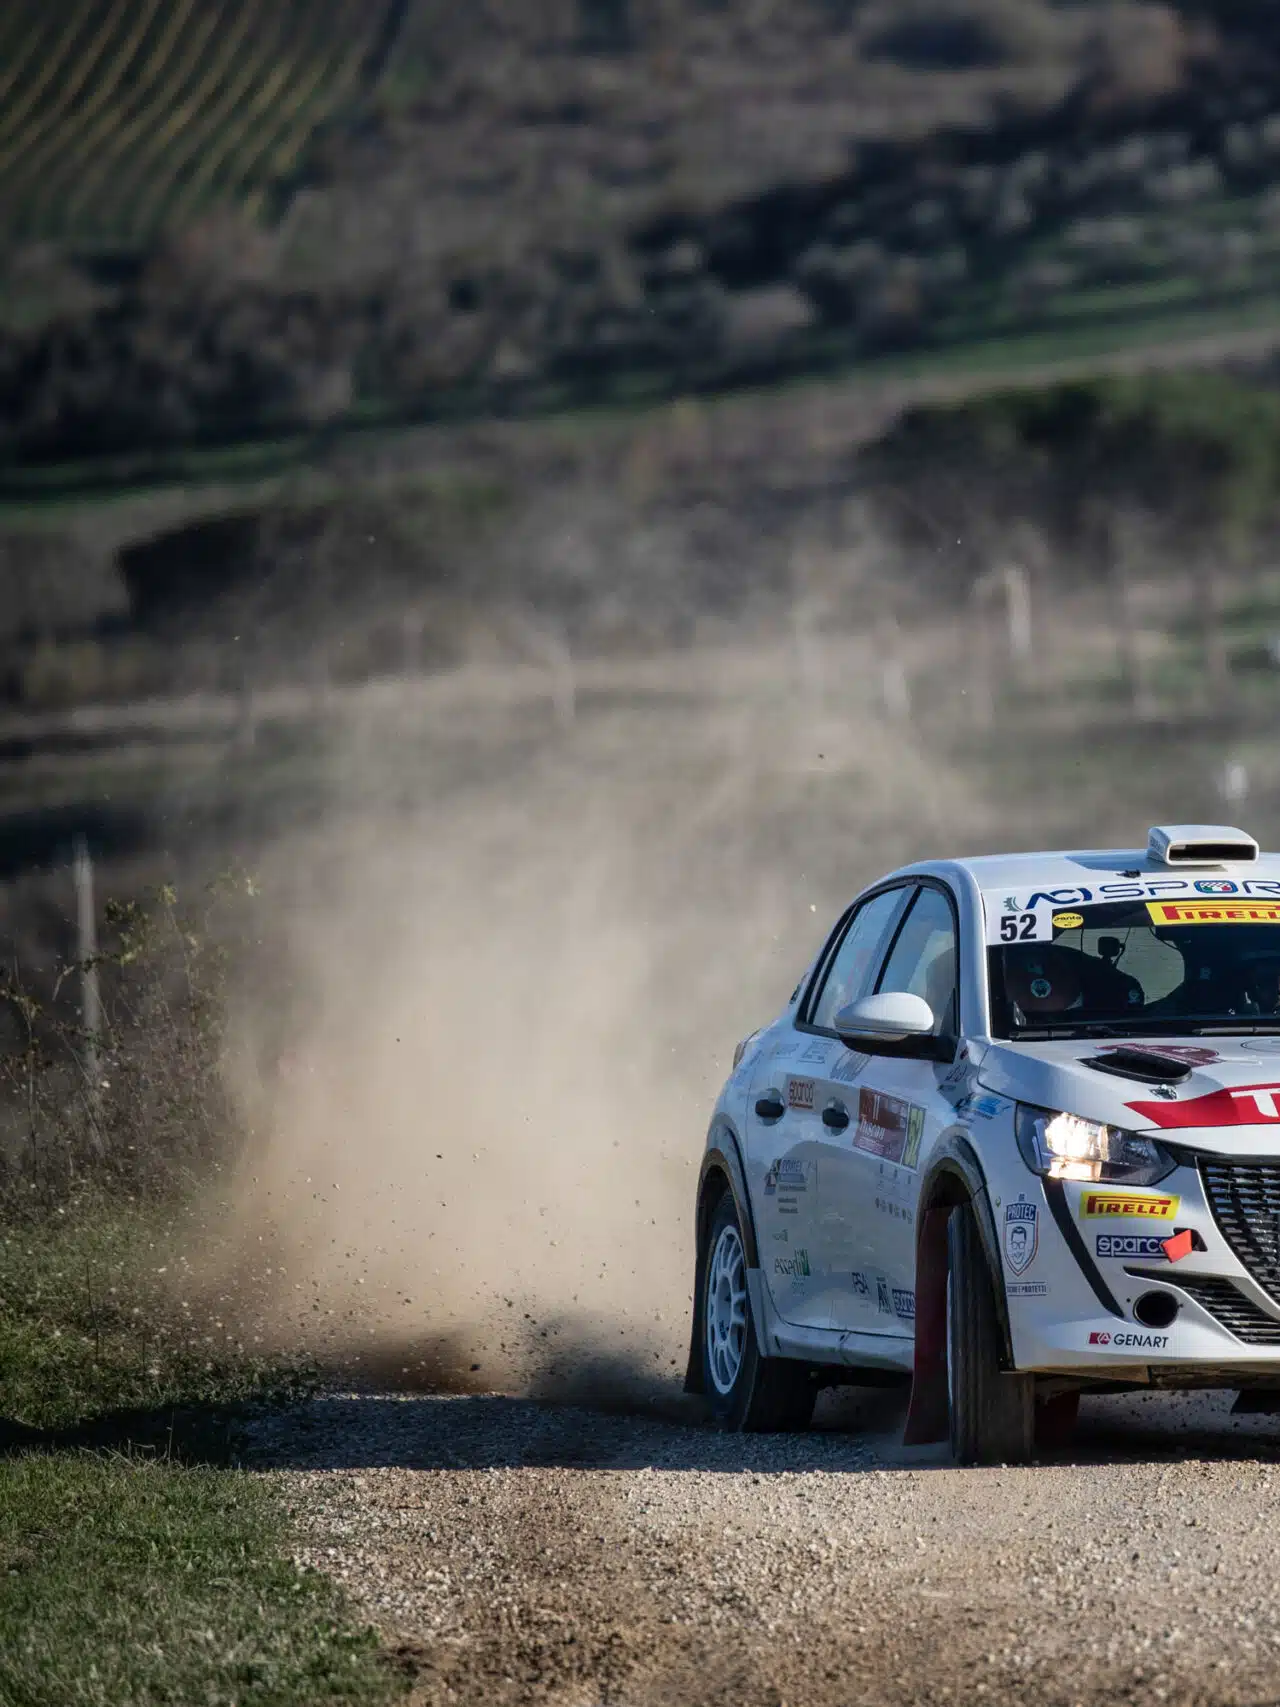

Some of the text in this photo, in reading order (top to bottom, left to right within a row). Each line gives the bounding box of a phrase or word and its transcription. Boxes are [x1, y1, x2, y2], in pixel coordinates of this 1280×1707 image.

[1000, 913, 1037, 941] 52
[1007, 1204, 1035, 1221] PROTEC
[1087, 1195, 1171, 1215] PIRELLI
[1098, 1236, 1168, 1256] sparc
[1113, 1333, 1169, 1348] GENART
